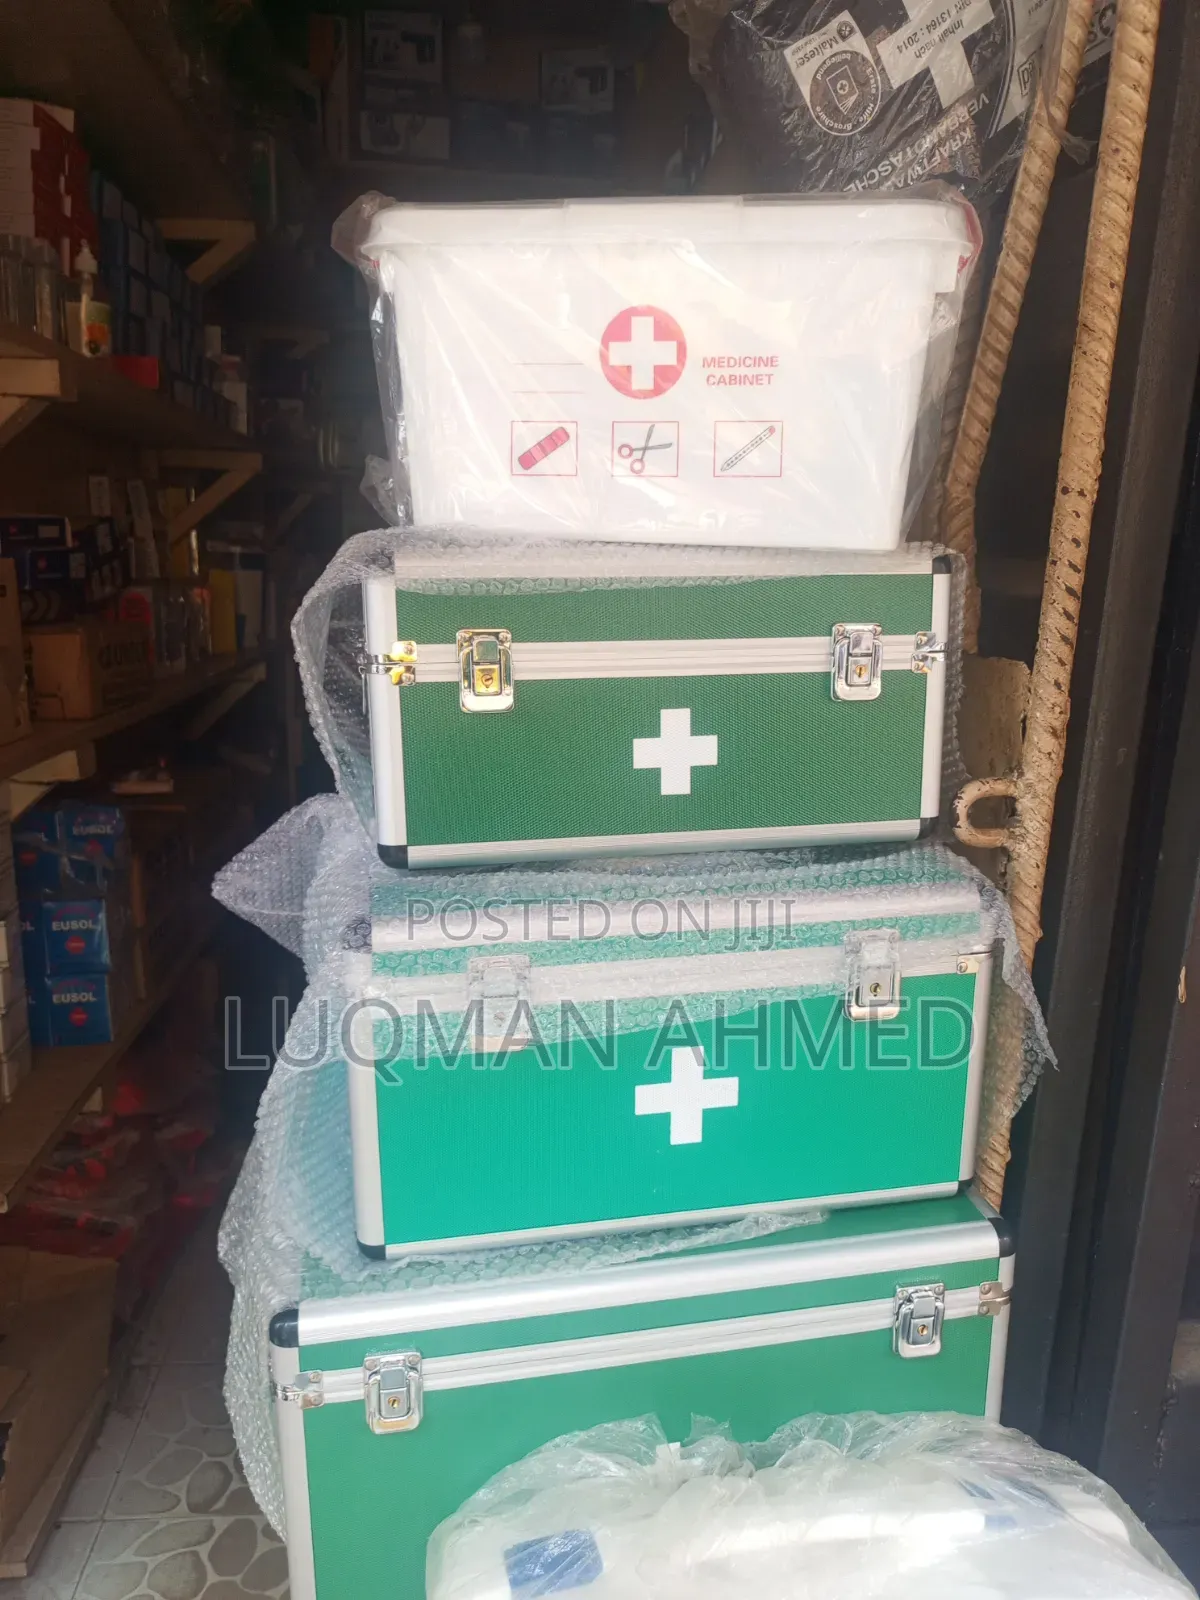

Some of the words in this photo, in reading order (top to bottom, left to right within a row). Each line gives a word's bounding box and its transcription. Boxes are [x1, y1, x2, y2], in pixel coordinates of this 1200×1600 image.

[926, 9, 951, 34] 13164
[896, 32, 920, 54] 2014
[914, 39, 936, 58] nach
[795, 36, 839, 68] Malteser
[702, 356, 780, 368] MEDICINE
[706, 373, 774, 386] CABINET
[51, 919, 98, 932] EUSOL
[52, 991, 98, 1005] EUSOL
